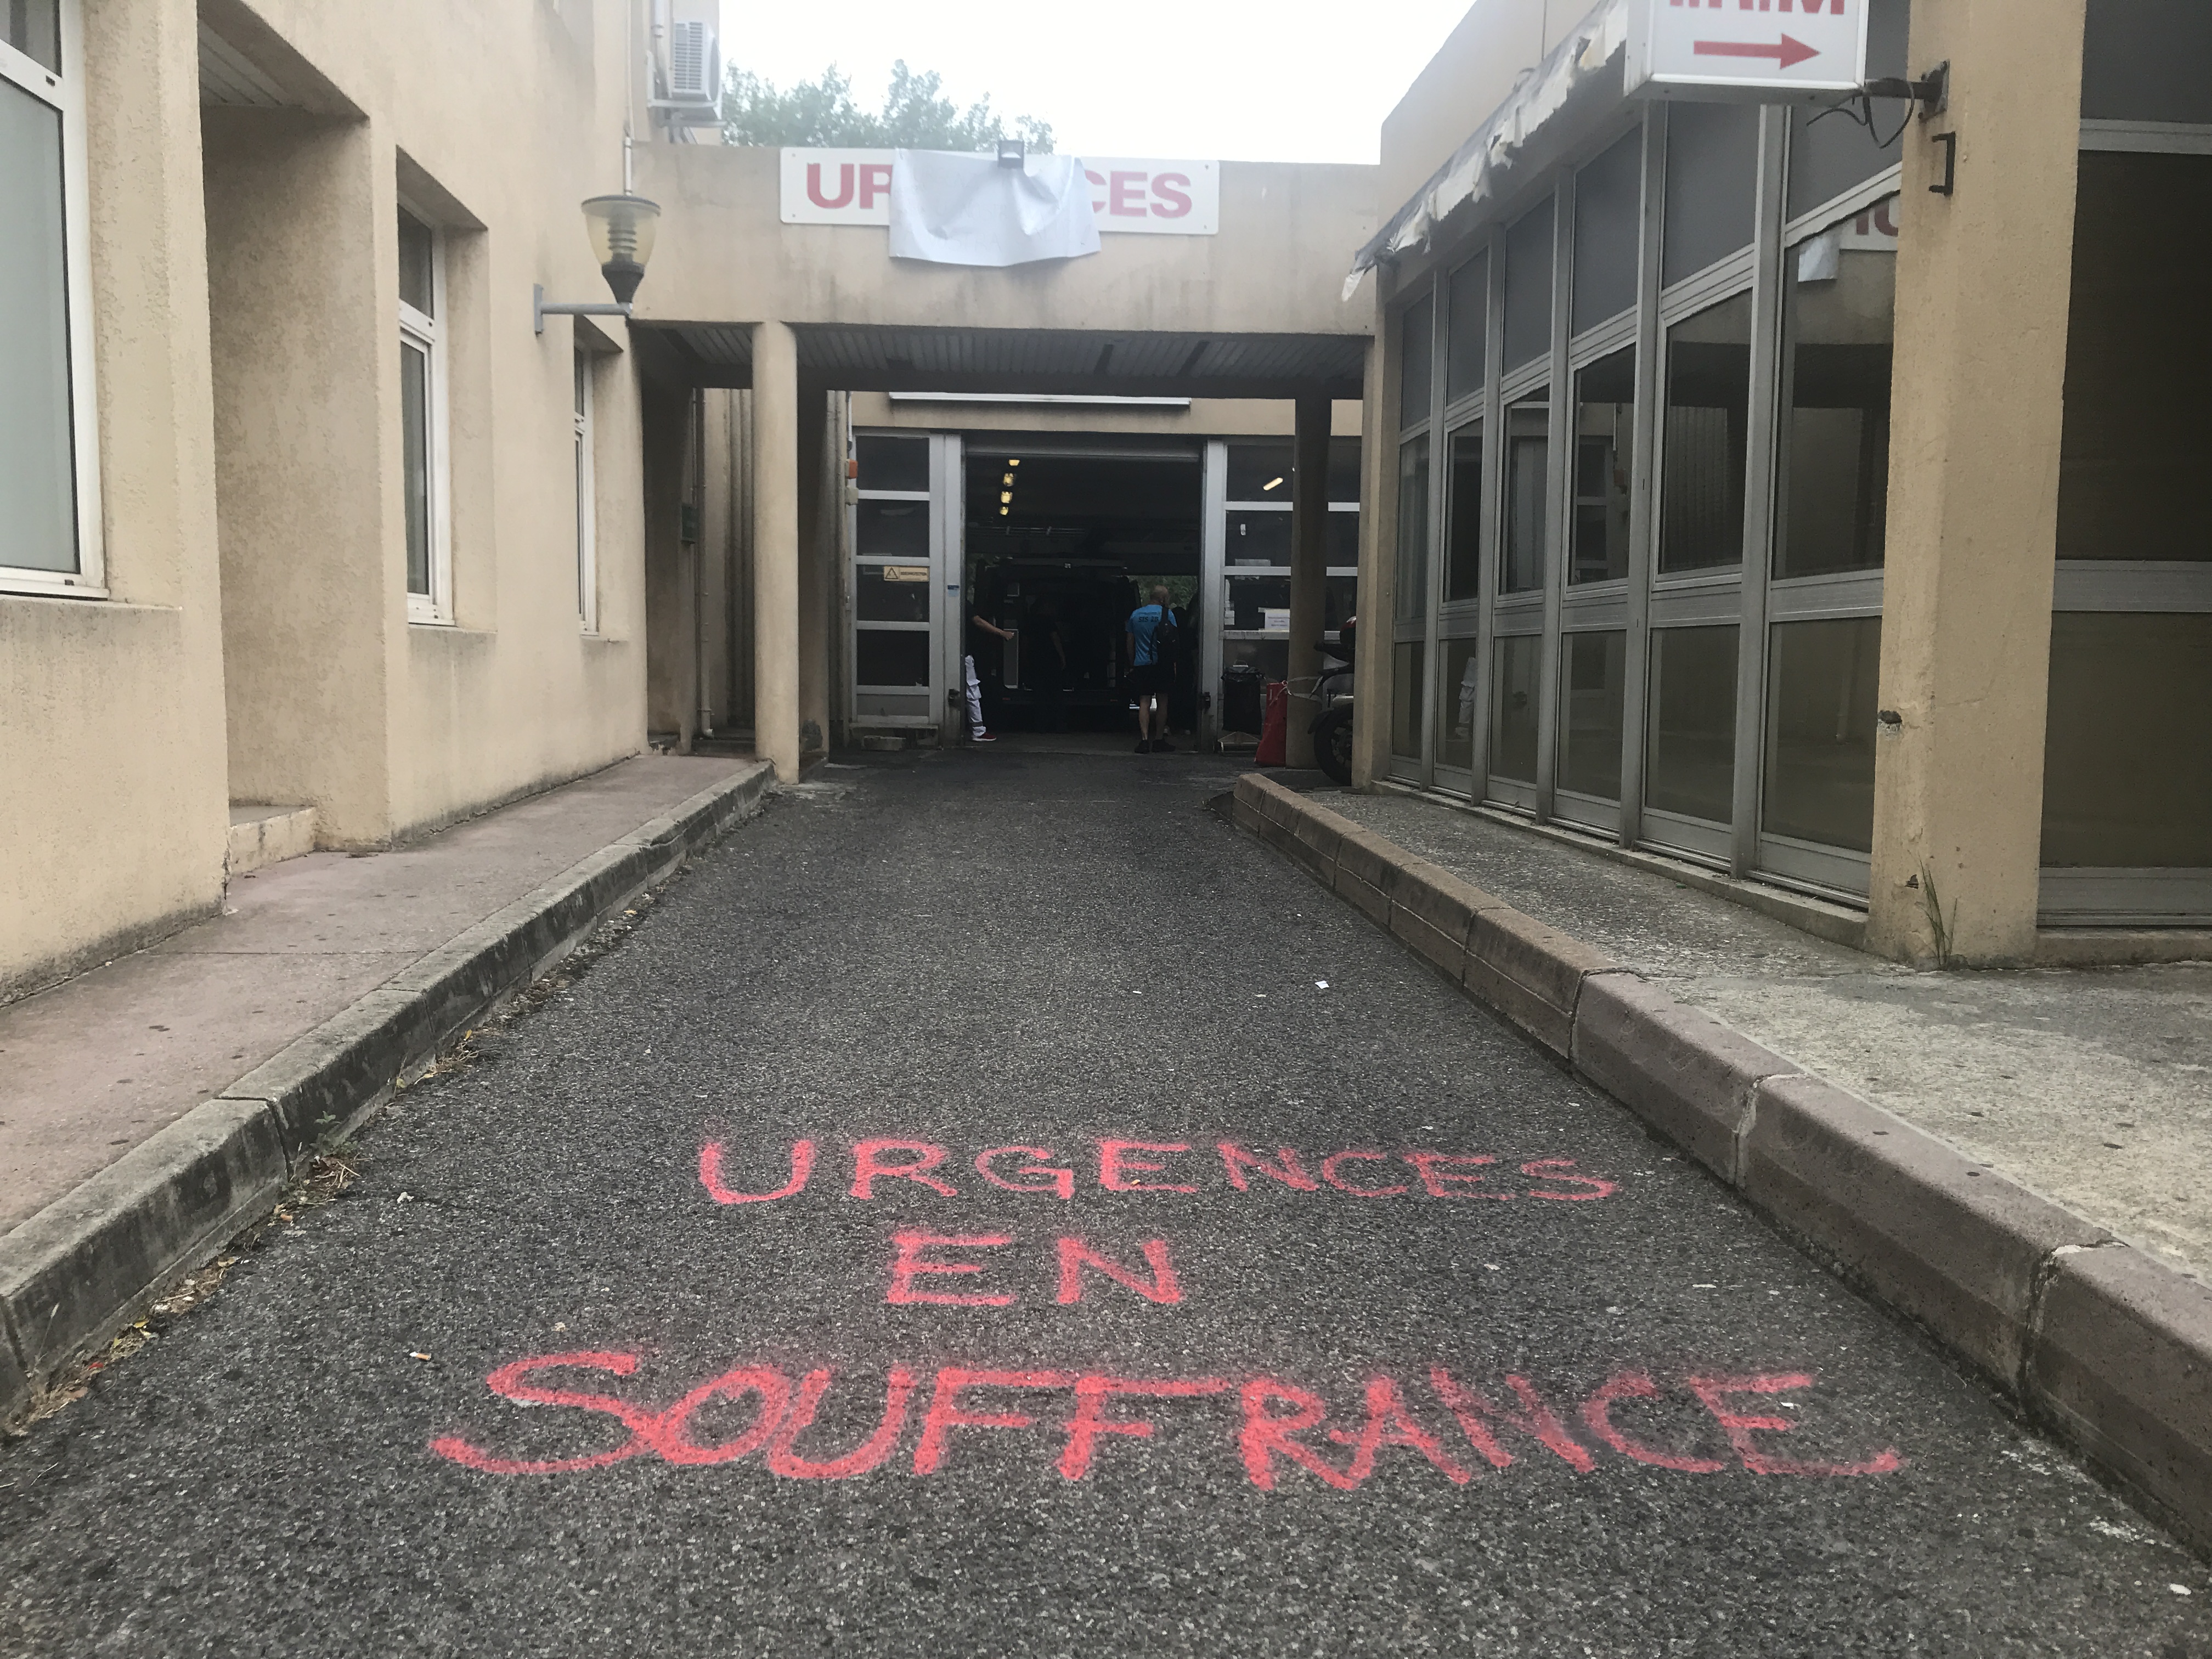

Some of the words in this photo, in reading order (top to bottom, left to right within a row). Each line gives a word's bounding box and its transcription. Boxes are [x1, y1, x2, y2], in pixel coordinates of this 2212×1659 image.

[806, 162, 1193, 219] URES
[698, 1138, 1617, 1205] URGENCES
[885, 1231, 1183, 1307] EN
[428, 1350, 1905, 1493] SOUFFRANCE
